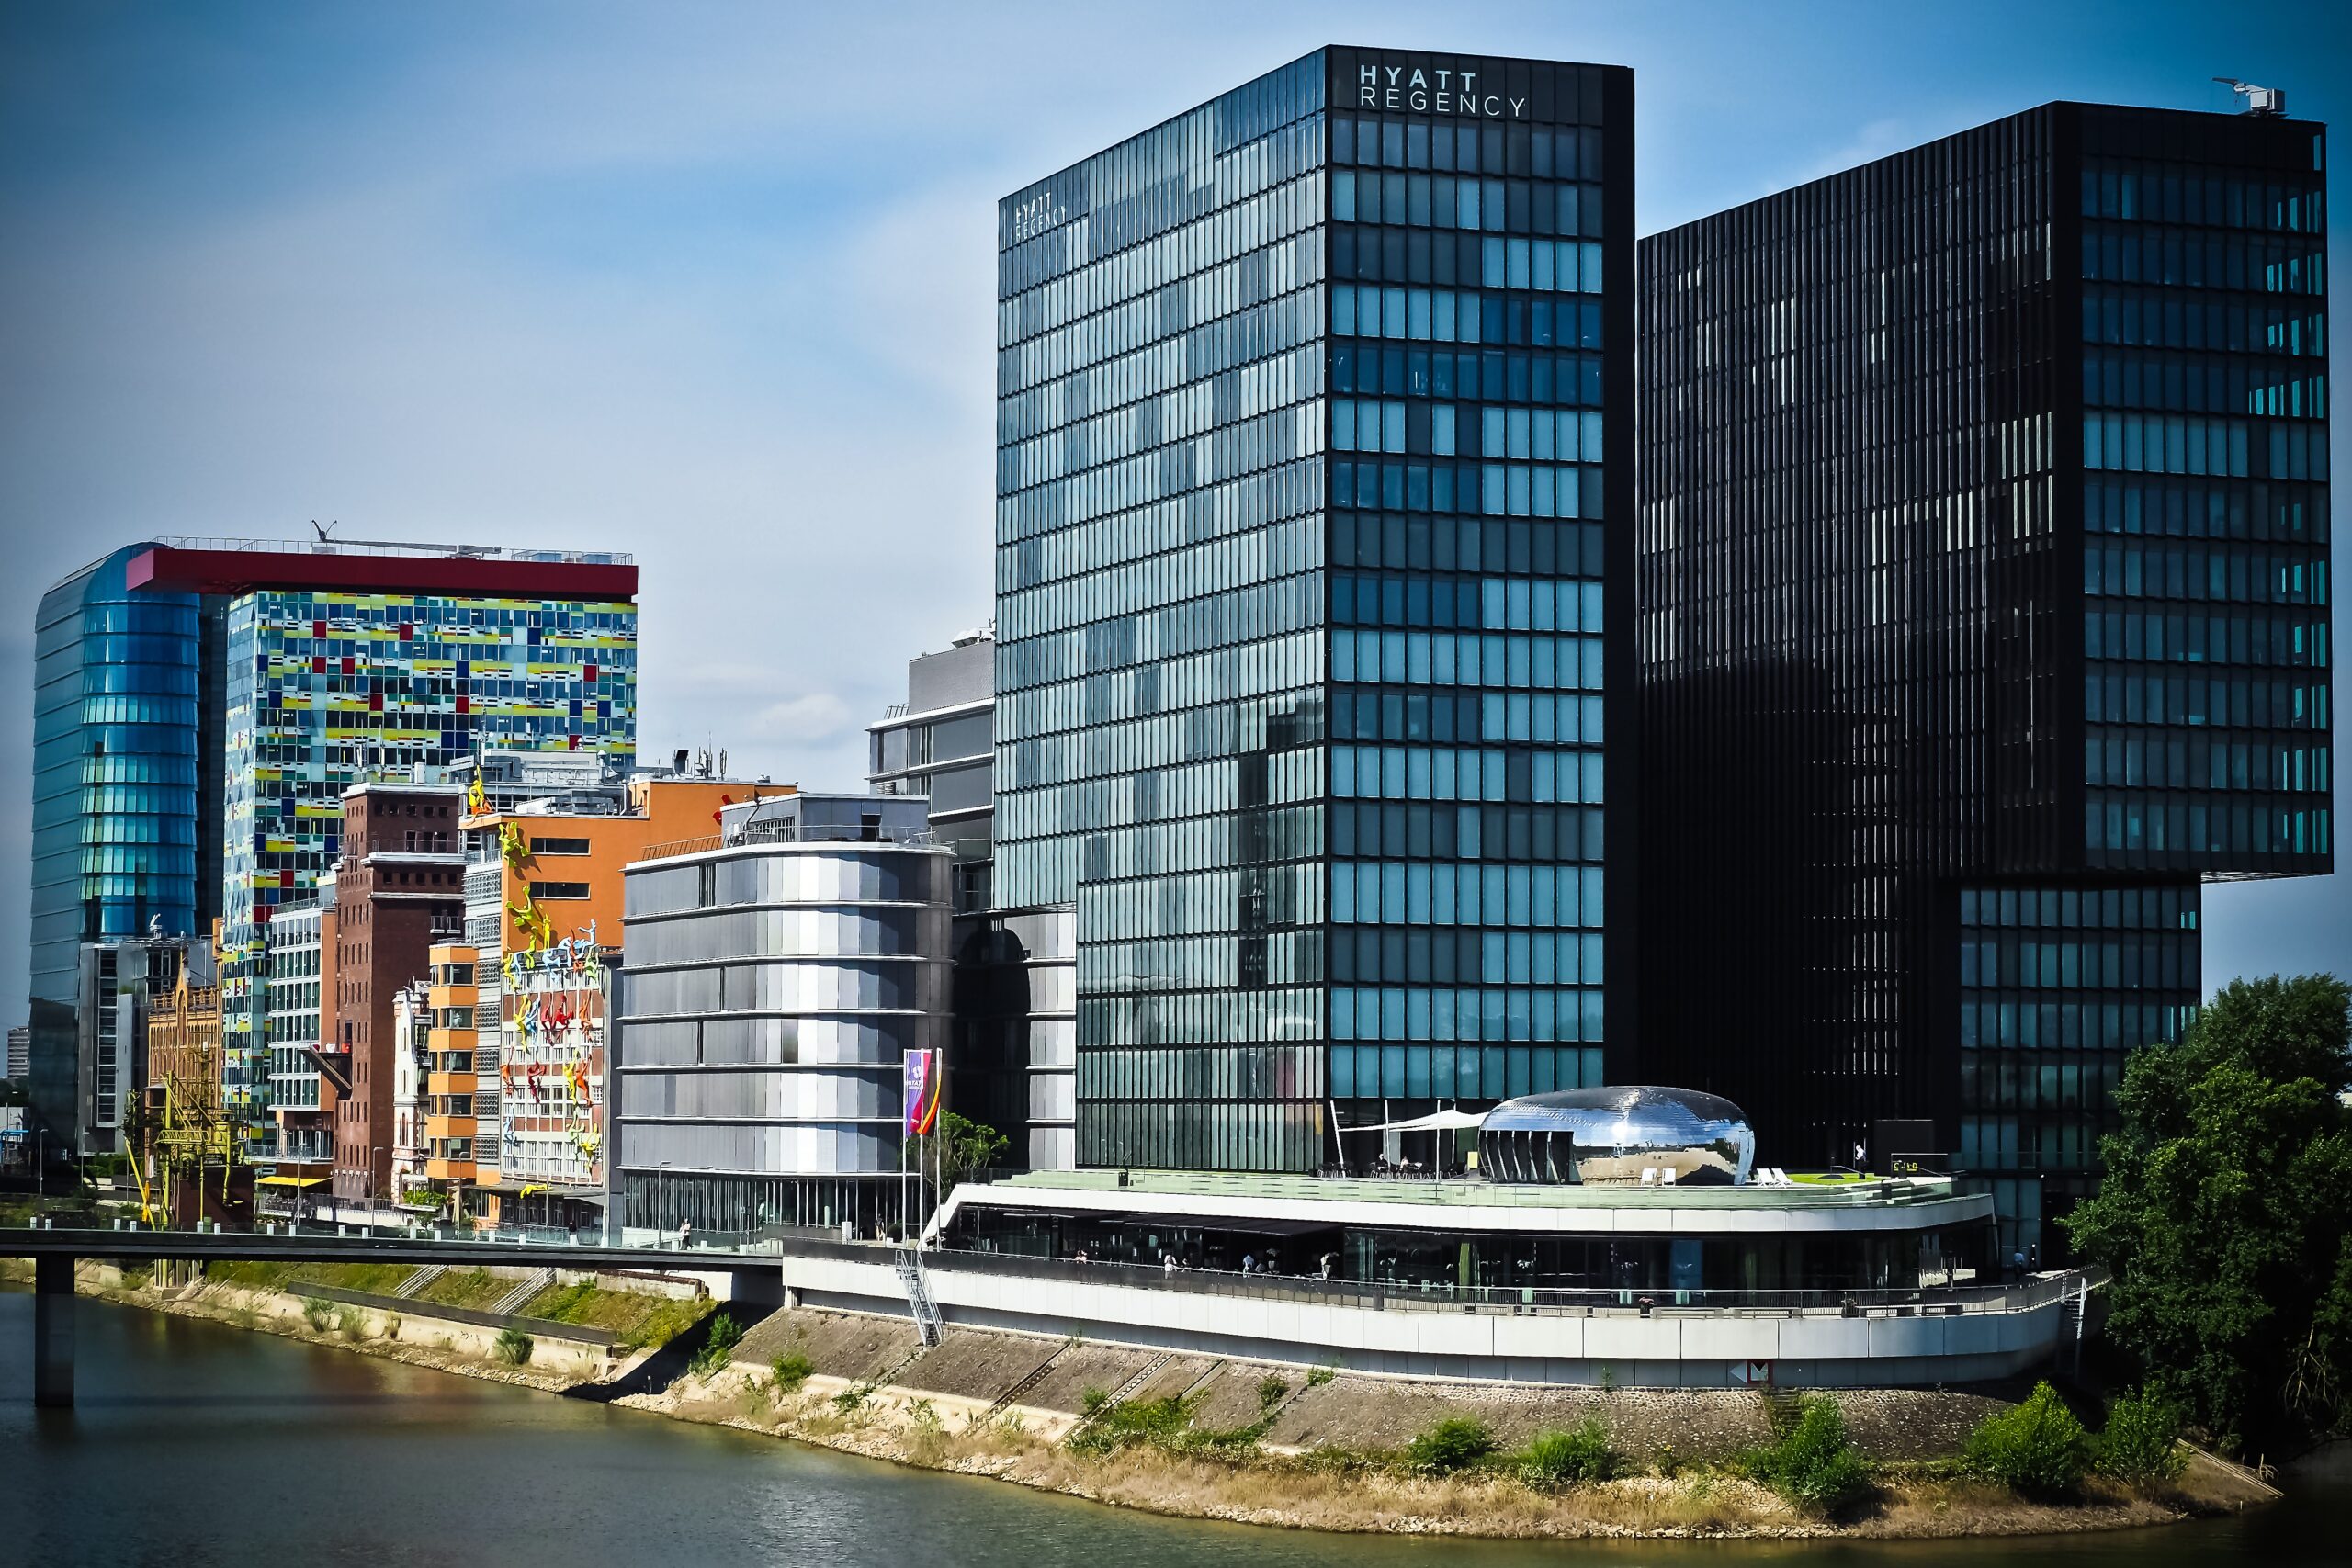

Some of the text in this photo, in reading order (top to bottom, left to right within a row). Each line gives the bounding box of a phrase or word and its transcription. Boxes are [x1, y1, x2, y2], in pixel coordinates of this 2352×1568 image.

[1360, 64, 1476, 92] HYATT
[1361, 87, 1525, 117] REGENCY
[1015, 192, 1051, 224] HYATT
